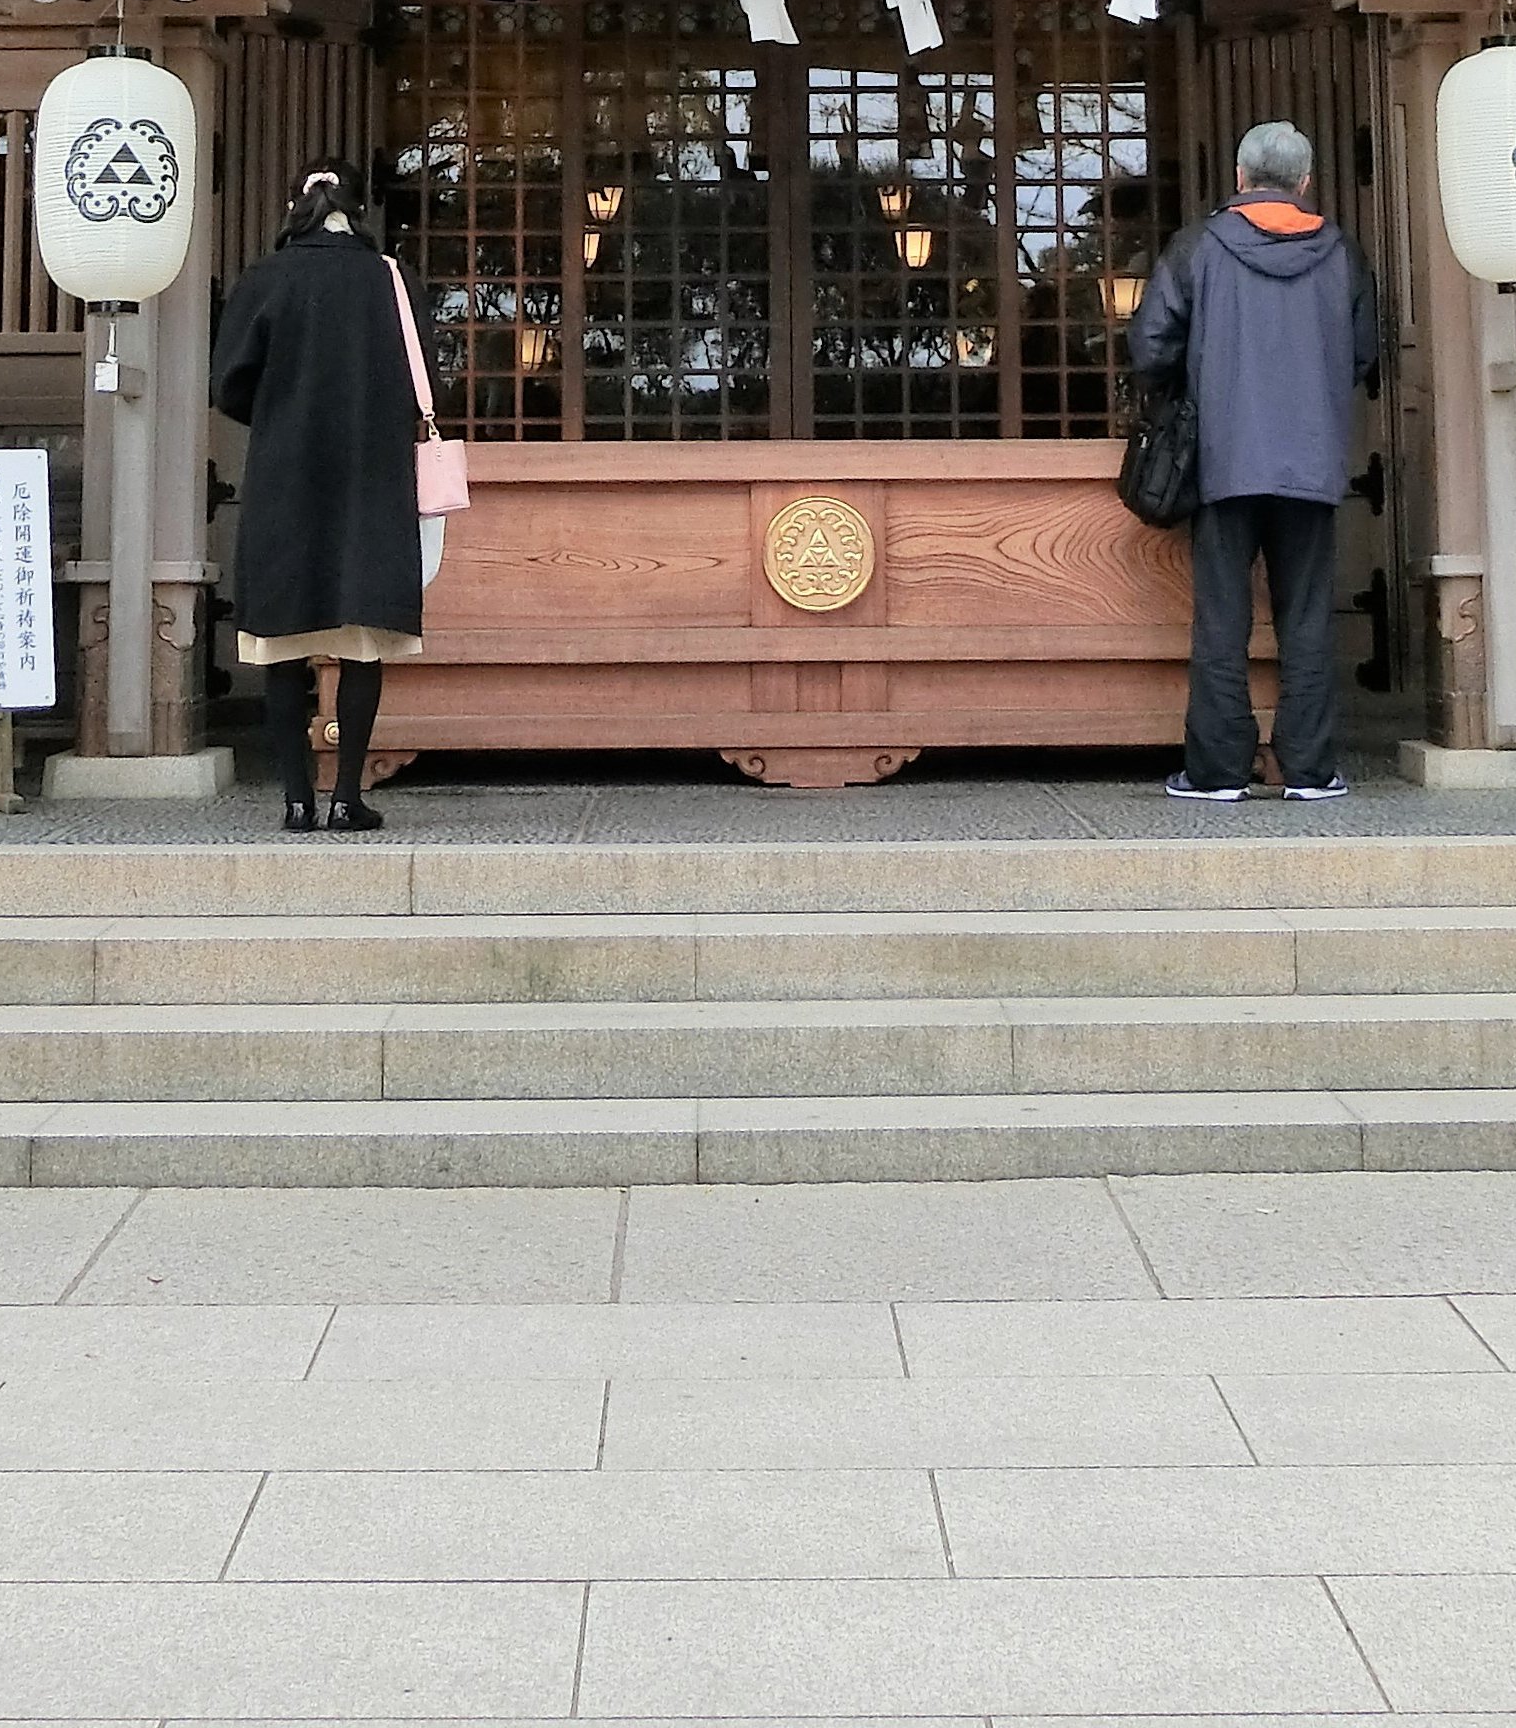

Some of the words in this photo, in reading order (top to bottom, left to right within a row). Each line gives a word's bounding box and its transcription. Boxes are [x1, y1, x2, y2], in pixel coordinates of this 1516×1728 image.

[11, 480, 38, 672] 厄除開運御祈祷案内
